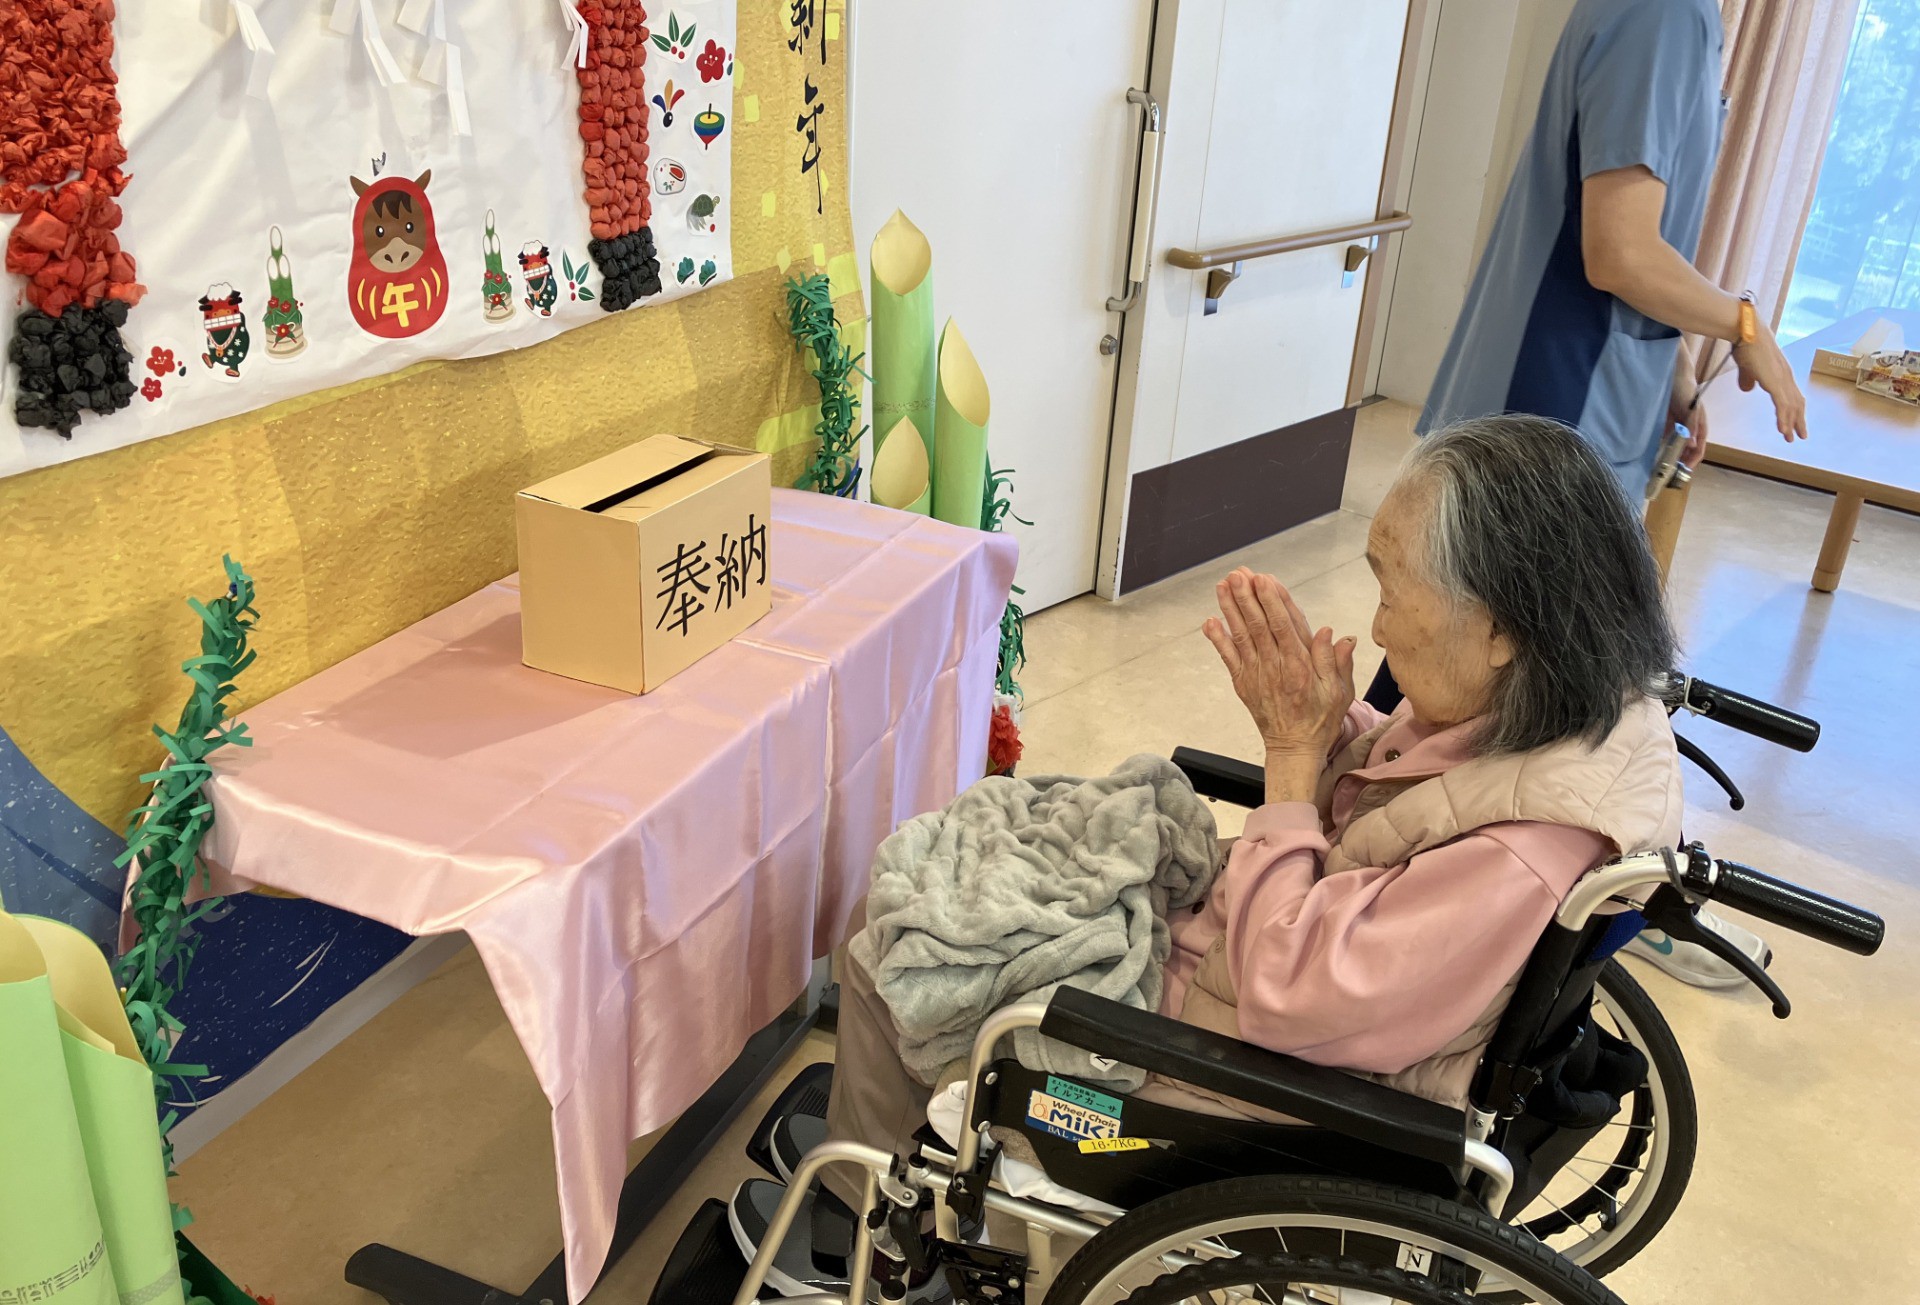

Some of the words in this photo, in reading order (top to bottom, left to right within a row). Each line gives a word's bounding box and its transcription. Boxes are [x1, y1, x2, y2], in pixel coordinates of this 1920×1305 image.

[381, 282, 419, 328] 午
[656, 514, 766, 637] 奉納
[1052, 1086, 1117, 1112] イルアカーサ
[1053, 1100, 1087, 1118] Wheel
[1088, 1114, 1117, 1128] Chair
[1047, 1125, 1069, 1139] BAL
